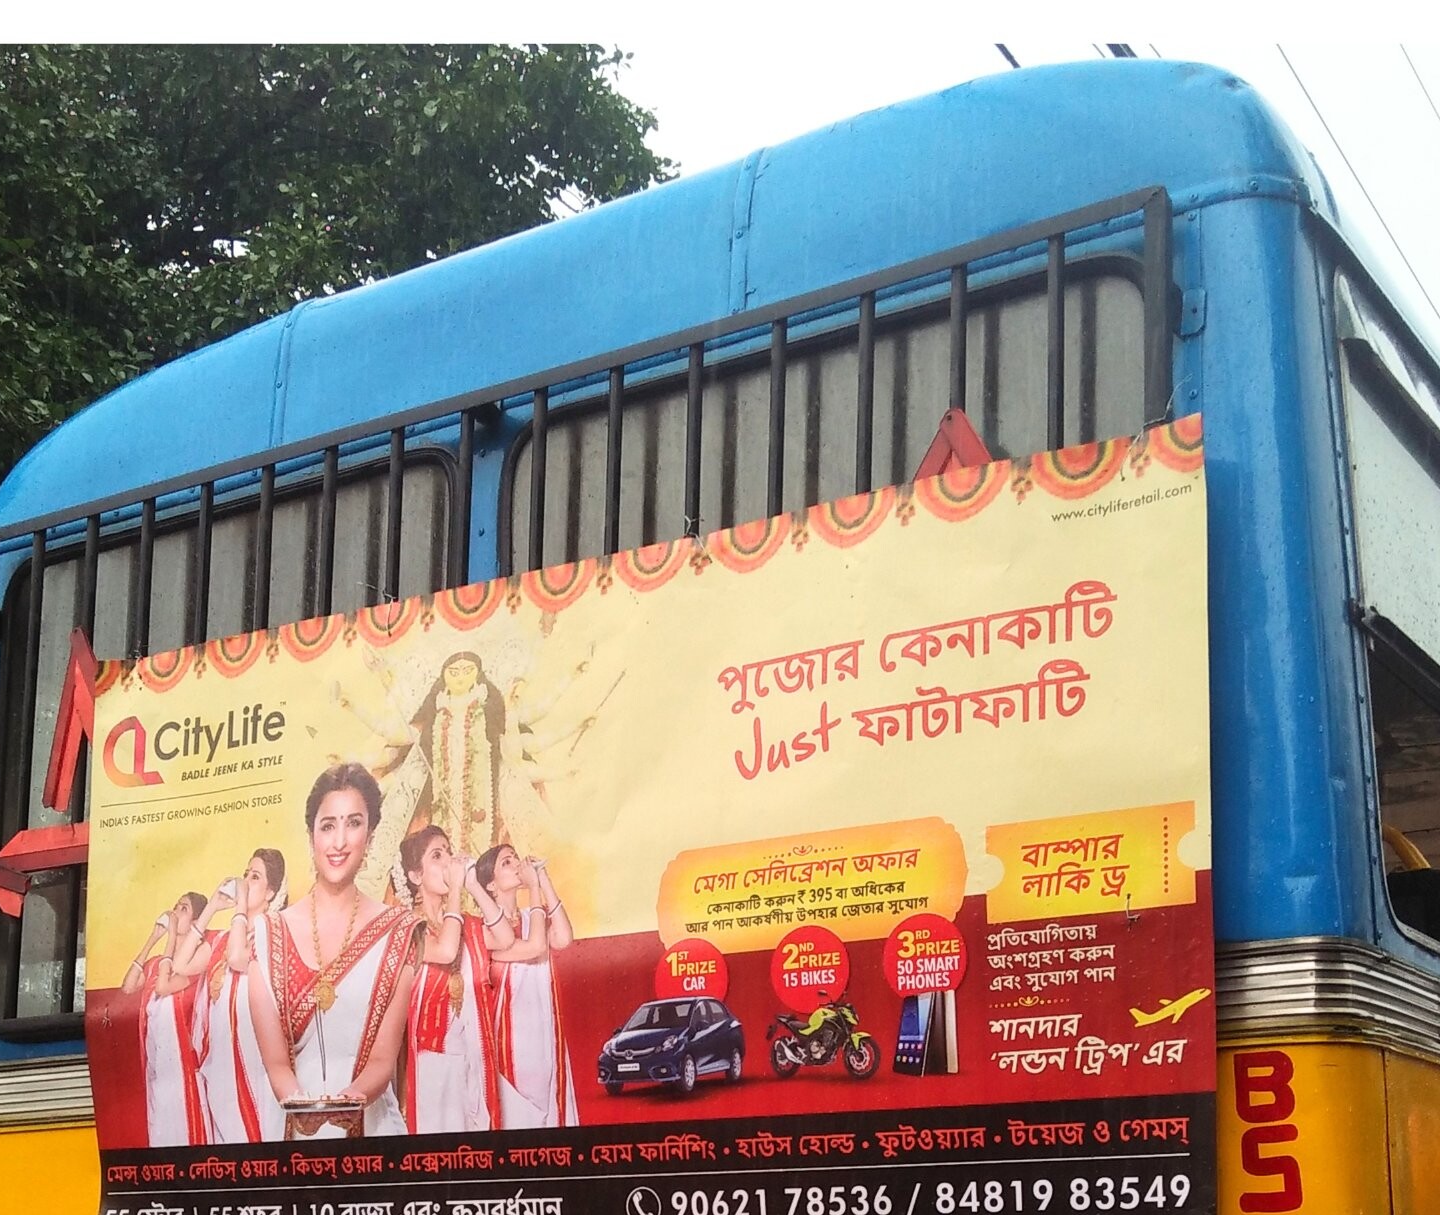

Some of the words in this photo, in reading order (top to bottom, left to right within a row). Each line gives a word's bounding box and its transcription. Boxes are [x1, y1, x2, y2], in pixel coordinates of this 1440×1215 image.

[1051, 484, 1192, 522] www.cityliferetail.com
[718, 639, 864, 714] পুজোর
[880, 580, 1118, 674] কেনাকাটি
[154, 704, 285, 762] CityLife
[735, 701, 841, 780] Just
[852, 659, 1091, 747] ফাটাফাটি
[181, 768, 210, 781] BADLE
[213, 765, 238, 777] JEENE
[241, 760, 254, 771] KA
[257, 755, 283, 769] STYLE
[132, 812, 165, 825] FASTEST
[167, 806, 211, 820] GROWING
[213, 799, 249, 815] FASHION
[252, 794, 282, 808] STORES
[694, 871, 738, 894] মেগা
[744, 859, 847, 888] সেলিব্রেশন
[852, 848, 921, 872] অফার
[1022, 862, 1095, 898] লাকি
[707, 895, 761, 915] কেনাকাটি
[764, 895, 795, 911] করুন
[809, 887, 833, 903] 395
[835, 888, 847, 900] বা
[851, 881, 905, 898] অধিকের
[686, 921, 708, 934] আর
[713, 918, 733, 931] পান
[796, 906, 837, 922] উপহার
[842, 903, 884, 917] জেতার
[888, 896, 929, 916] সুযোগ
[799, 952, 841, 968] PRIZE
[916, 939, 960, 956] PRIZE
[987, 947, 1065, 970] অংশগ্রহণ
[1068, 944, 1115, 964] করুন
[678, 961, 717, 976] PRIZE
[782, 972, 798, 987] 15
[801, 969, 836, 986] BIKES
[897, 959, 913, 975] 50
[916, 955, 960, 973] SMART
[989, 974, 1020, 992] এবং
[1025, 969, 1079, 992] সুযোগ
[1084, 966, 1116, 982] পান
[683, 976, 706, 991] CAR
[897, 972, 950, 990] PHONES
[989, 1013, 1083, 1042] শানদার
[1143, 1038, 1187, 1066] এর
[509, 1147, 572, 1167] লাগেজ
[591, 1143, 633, 1164] হোম
[736, 1131, 793, 1158] হাউস
[1092, 1120, 1111, 1143] ও
[935, 1179, 1053, 1214] 84819
[1069, 1174, 1190, 1211] 83549
